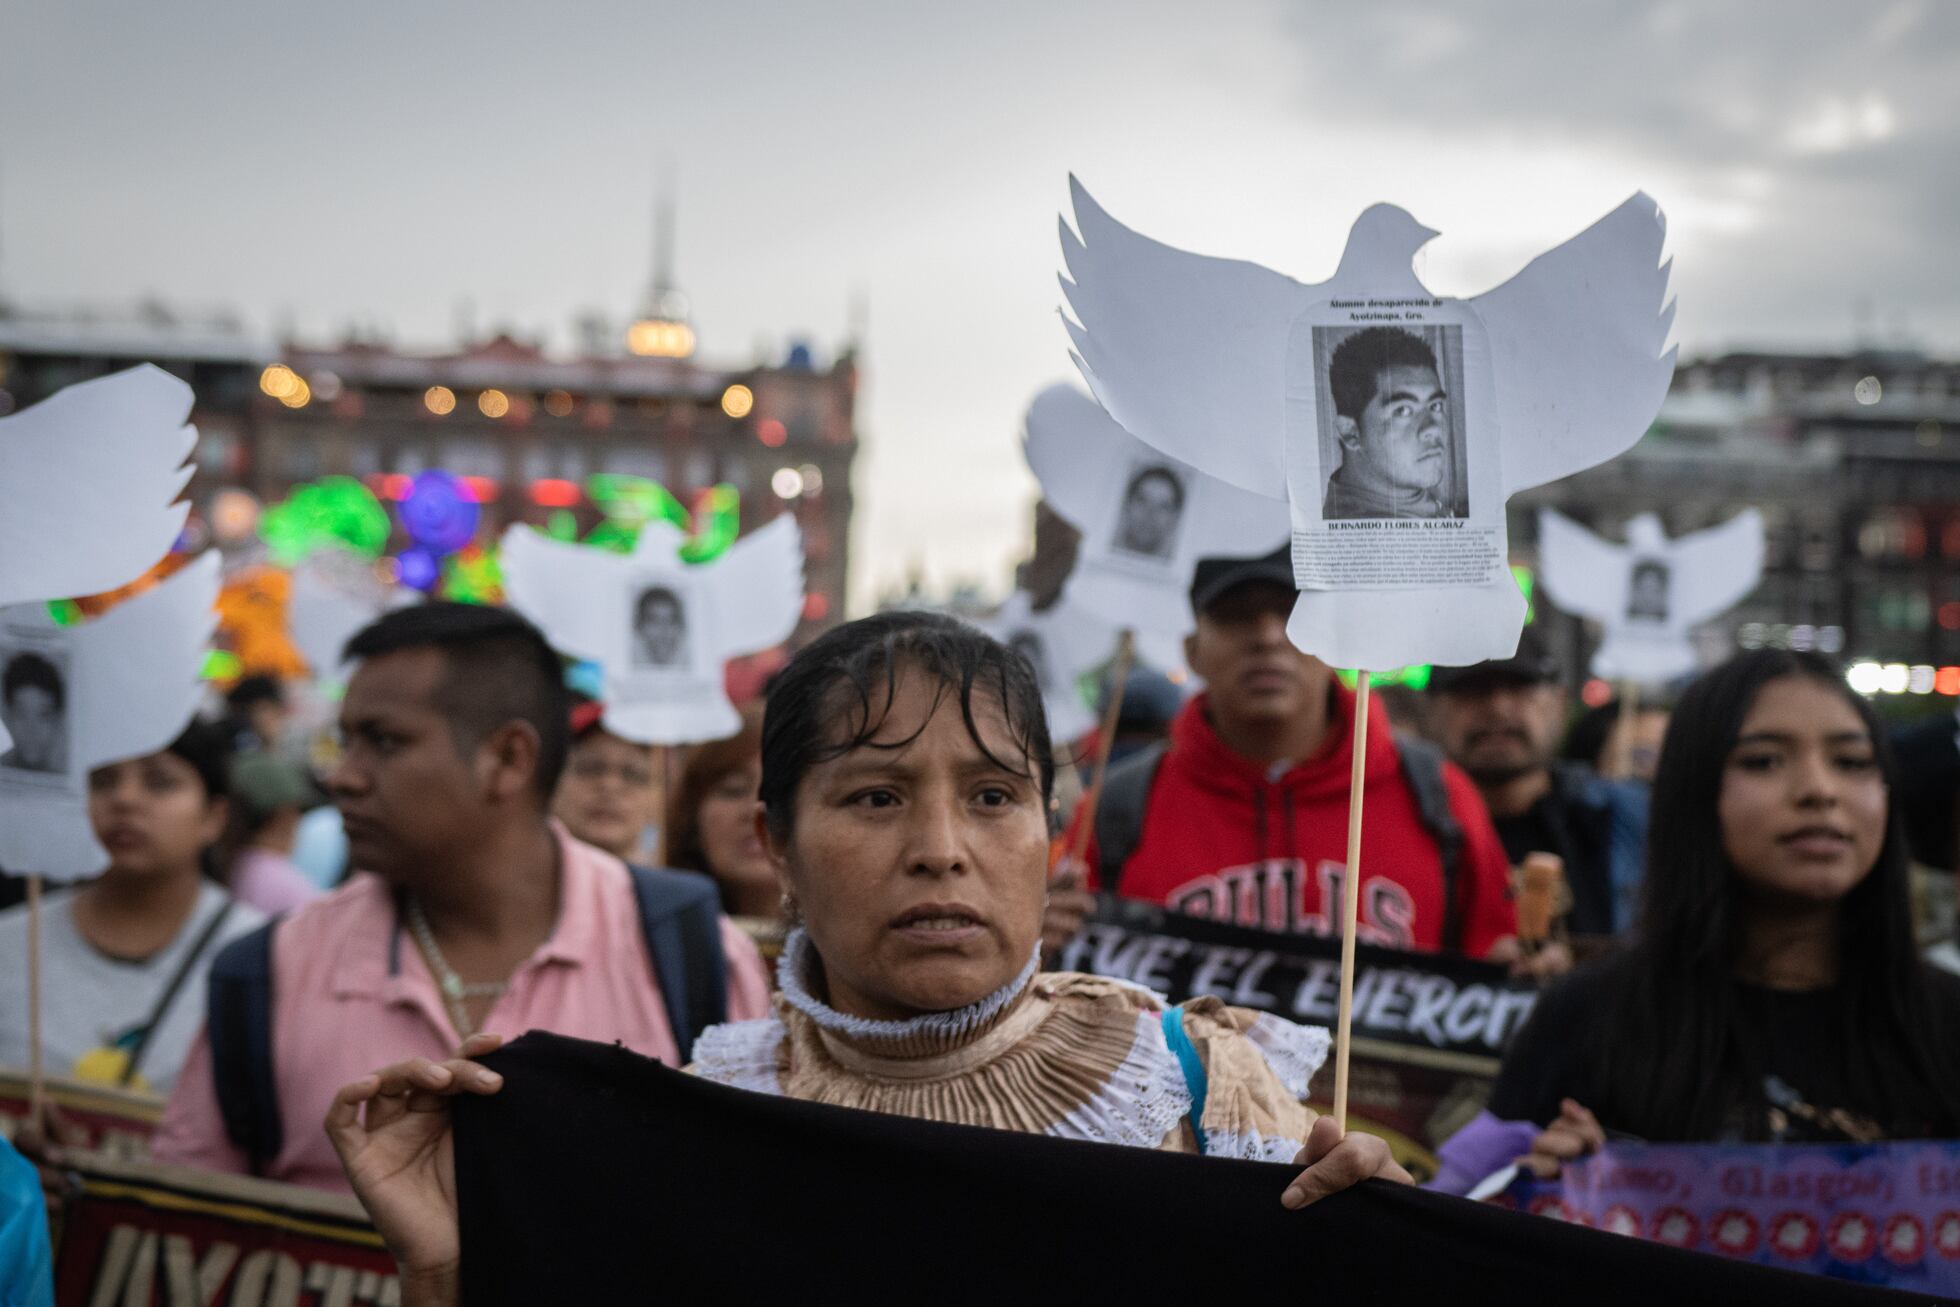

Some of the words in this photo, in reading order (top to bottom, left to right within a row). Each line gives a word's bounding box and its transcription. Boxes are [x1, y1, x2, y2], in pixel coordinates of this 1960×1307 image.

[1330, 300, 1365, 308] Alumno
[1368, 299, 1430, 309] desaparecido
[1433, 298, 1443, 306] de
[1350, 312, 1402, 321] Ayotzinapa,
[1406, 311, 1425, 321] Gro.
[1328, 522, 1382, 530] BERNARDO
[1385, 522, 1420, 530] FLORES
[1423, 520, 1465, 529] ALCARAZ
[1192, 945, 1278, 1007] EL
